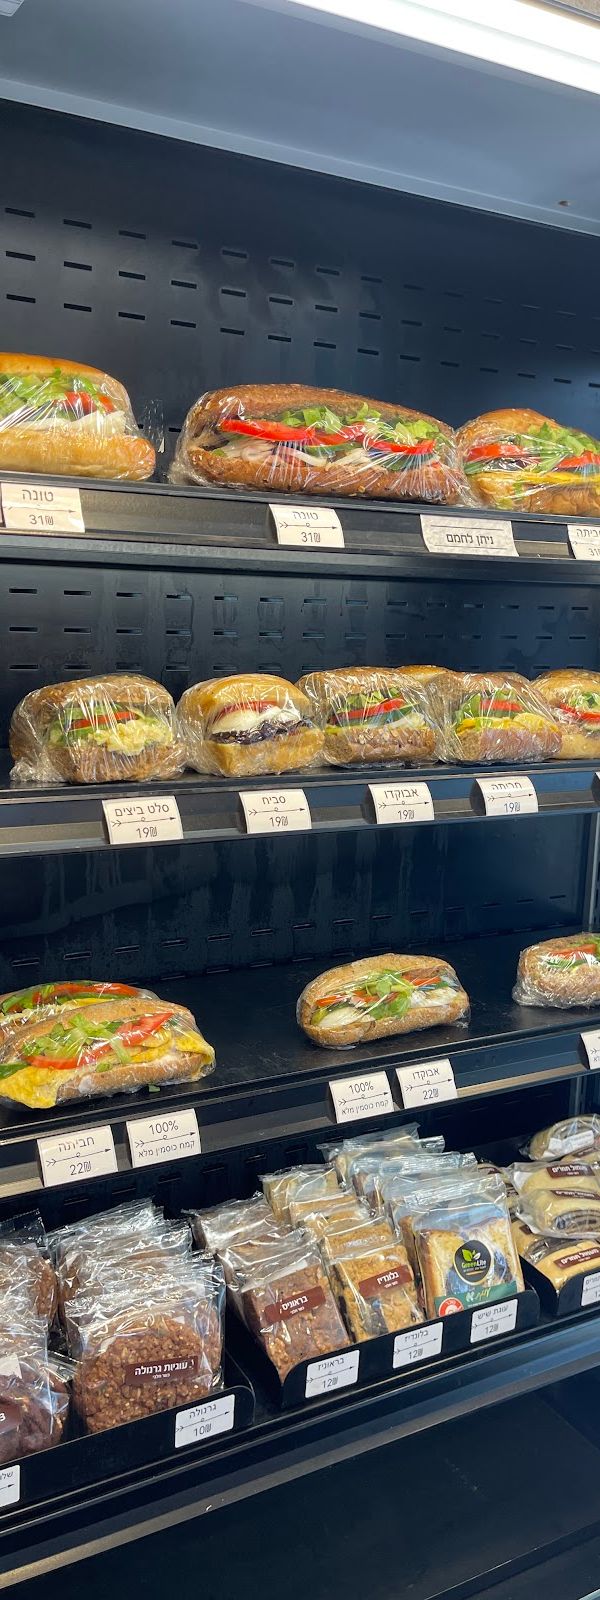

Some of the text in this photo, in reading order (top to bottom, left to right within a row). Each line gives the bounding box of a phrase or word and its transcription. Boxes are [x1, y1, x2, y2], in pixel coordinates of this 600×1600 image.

[22, 489, 54, 502] טונה
[292, 511, 319, 520] טונה
[446, 533, 494, 546] ניתן לחמם
[576, 528, 600, 538] ביתה
[262, 795, 286, 805] סביח
[384, 788, 419, 801] אבוקדו
[115, 803, 170, 817] סלט ביצים
[412, 1067, 440, 1080] אבוקדו
[348, 1081, 374, 1094] 100%
[376, 1100, 389, 1109] קמח
[148, 1120, 179, 1135] 100%
[58, 1136, 95, 1152] חביתה
[179, 1141, 195, 1149] קמח
[138, 1149, 154, 1158] מלא
[281, 1295, 309, 1311] בראוניס
[477, 1310, 492, 1319] שיש
[404, 1329, 429, 1342] בלונדיז
[134, 1361, 188, 1376] עוגיות גרנולה
[318, 1357, 345, 1371] בראוניז
[189, 1403, 217, 1419] גרנולה
